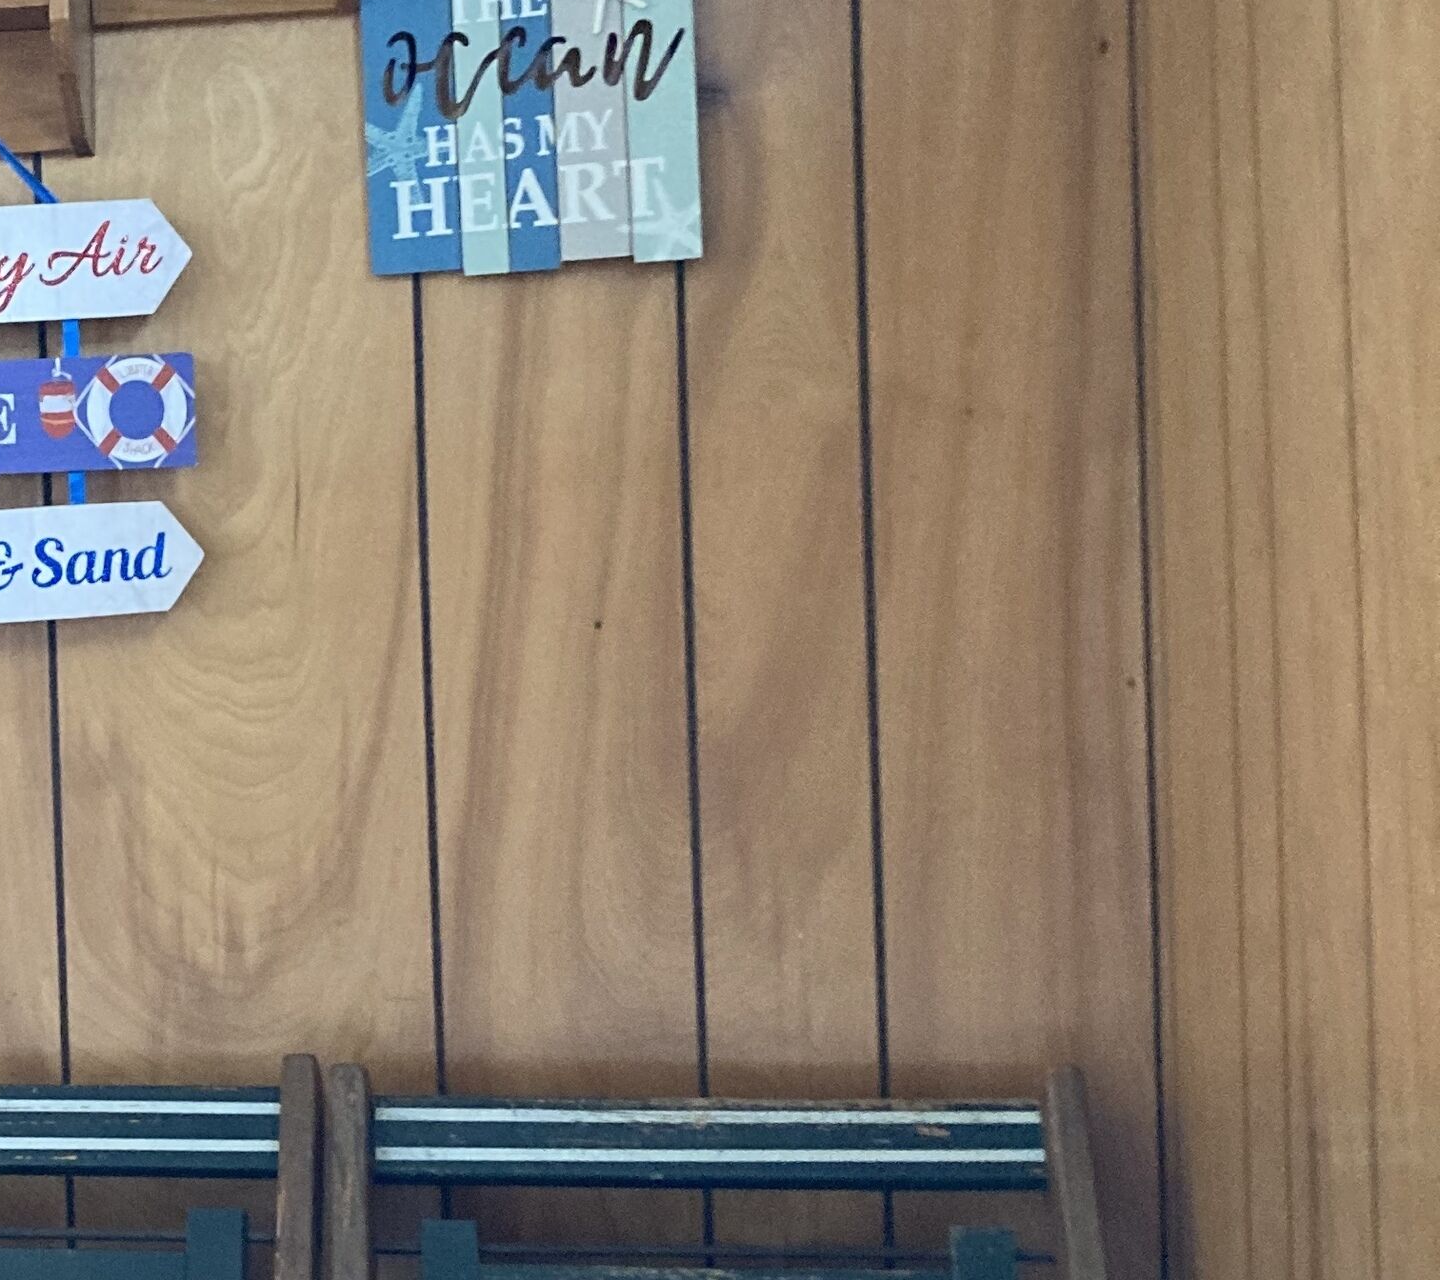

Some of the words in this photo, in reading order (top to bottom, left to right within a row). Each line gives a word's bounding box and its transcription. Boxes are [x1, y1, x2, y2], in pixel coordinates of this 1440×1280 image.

[383, 19, 685, 118] ocean
[423, 117, 525, 167] HAS
[534, 108, 613, 157] MY
[389, 156, 665, 240] HEART
[39, 220, 163, 286] Air
[31, 531, 173, 588] Sand
